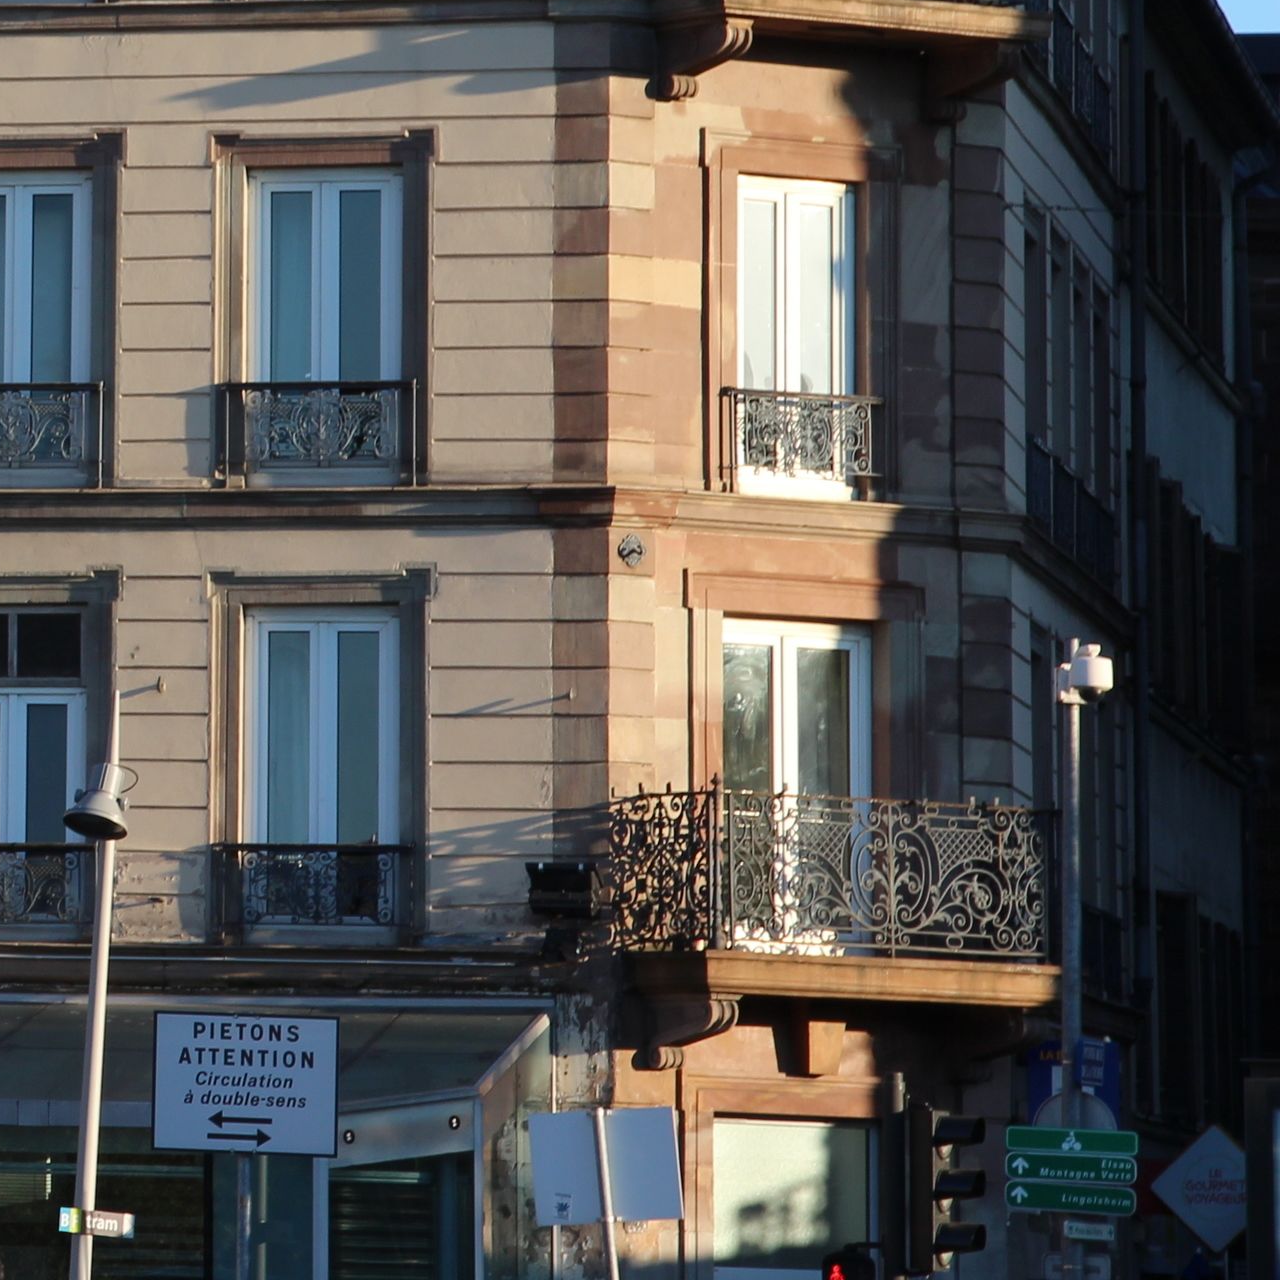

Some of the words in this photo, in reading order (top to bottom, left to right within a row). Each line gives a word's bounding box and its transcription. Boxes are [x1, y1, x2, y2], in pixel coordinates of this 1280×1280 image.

[193, 1021, 300, 1043] PIETONS
[178, 1046, 315, 1069] ATTENTION
[195, 1071, 293, 1089] Circulation
[183, 1089, 194, 1104] à
[200, 1089, 307, 1109] double-sens
[1101, 1159, 1132, 1169] Elsau
[1040, 1167, 1096, 1180] Montagne
[1101, 1170, 1132, 1180] Verte
[1061, 1193, 1131, 1207] Lingolsheim
[60, 1213, 70, 1227] B
[85, 1214, 119, 1232] tram
